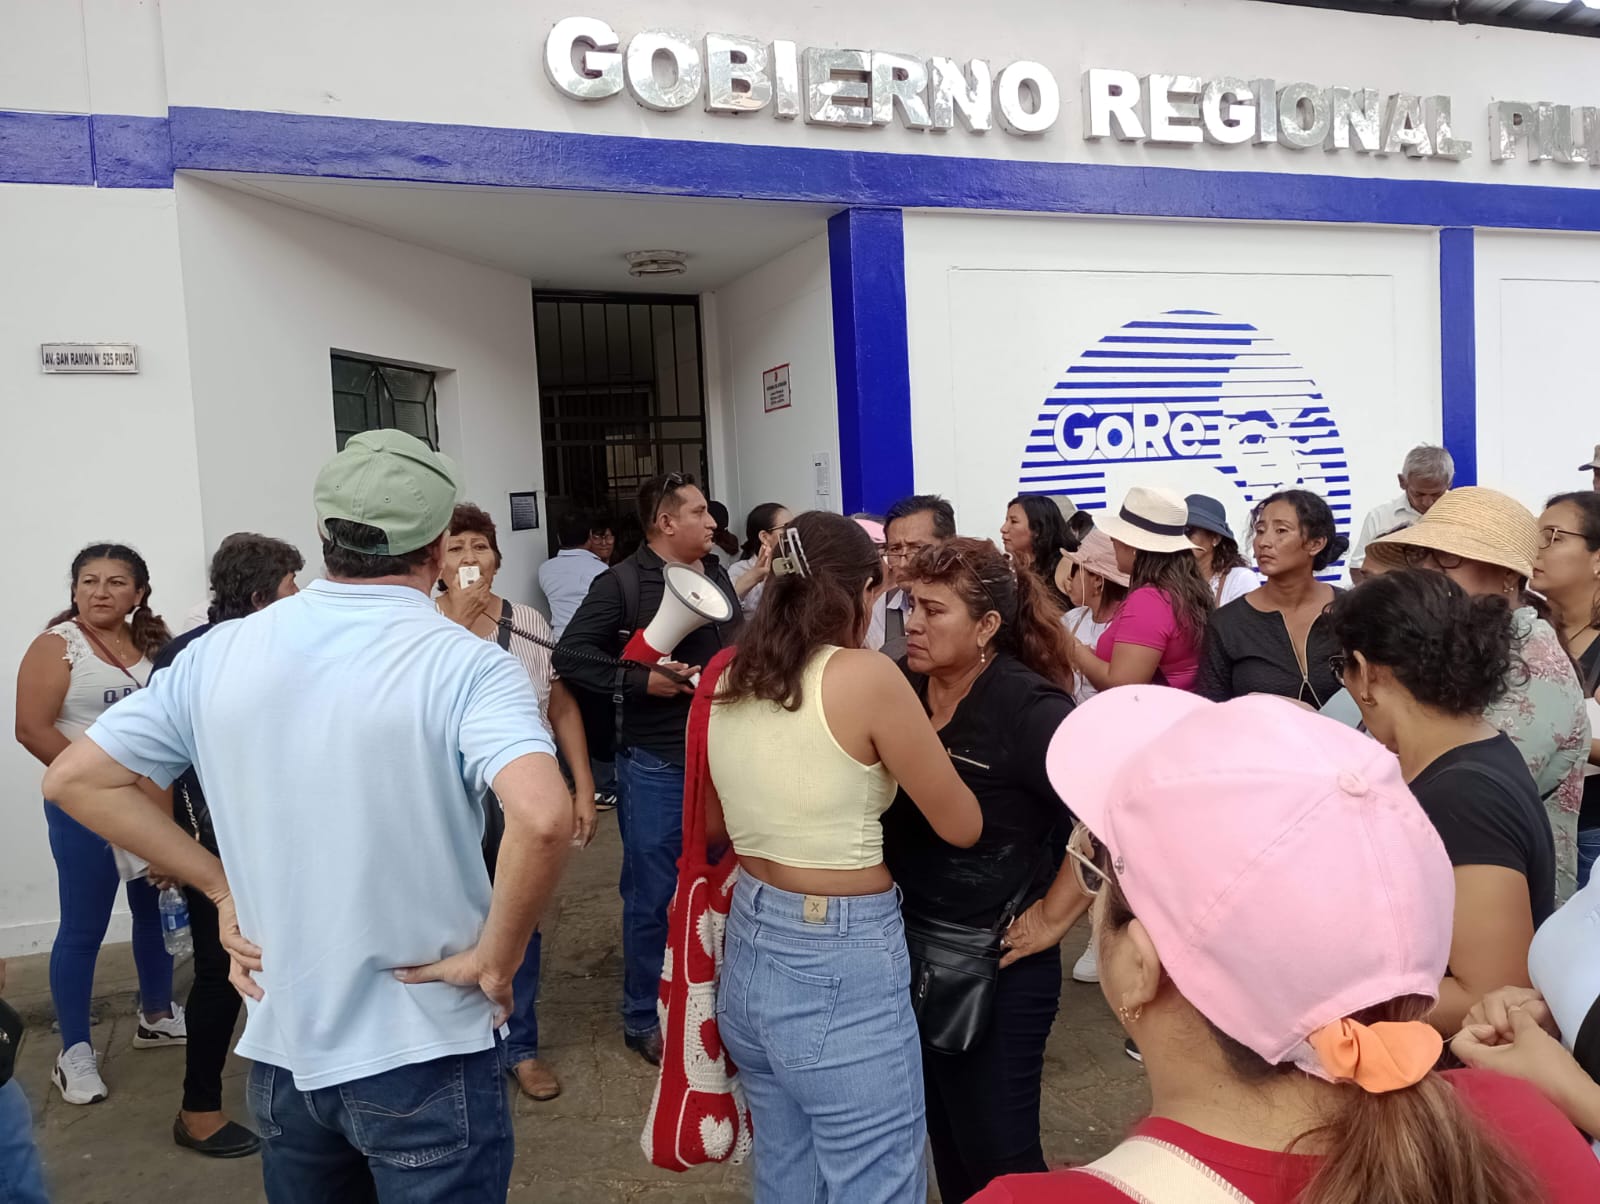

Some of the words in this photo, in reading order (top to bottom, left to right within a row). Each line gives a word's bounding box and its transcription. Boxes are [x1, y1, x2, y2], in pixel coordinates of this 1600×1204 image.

[543, 16, 1060, 135] GOBIERNO
[1082, 68, 1472, 160] REGIONAL
[1488, 101, 1600, 166] PIU
[56, 352, 69, 366] SAN
[103, 352, 114, 366] 525
[115, 352, 134, 366] PIURA
